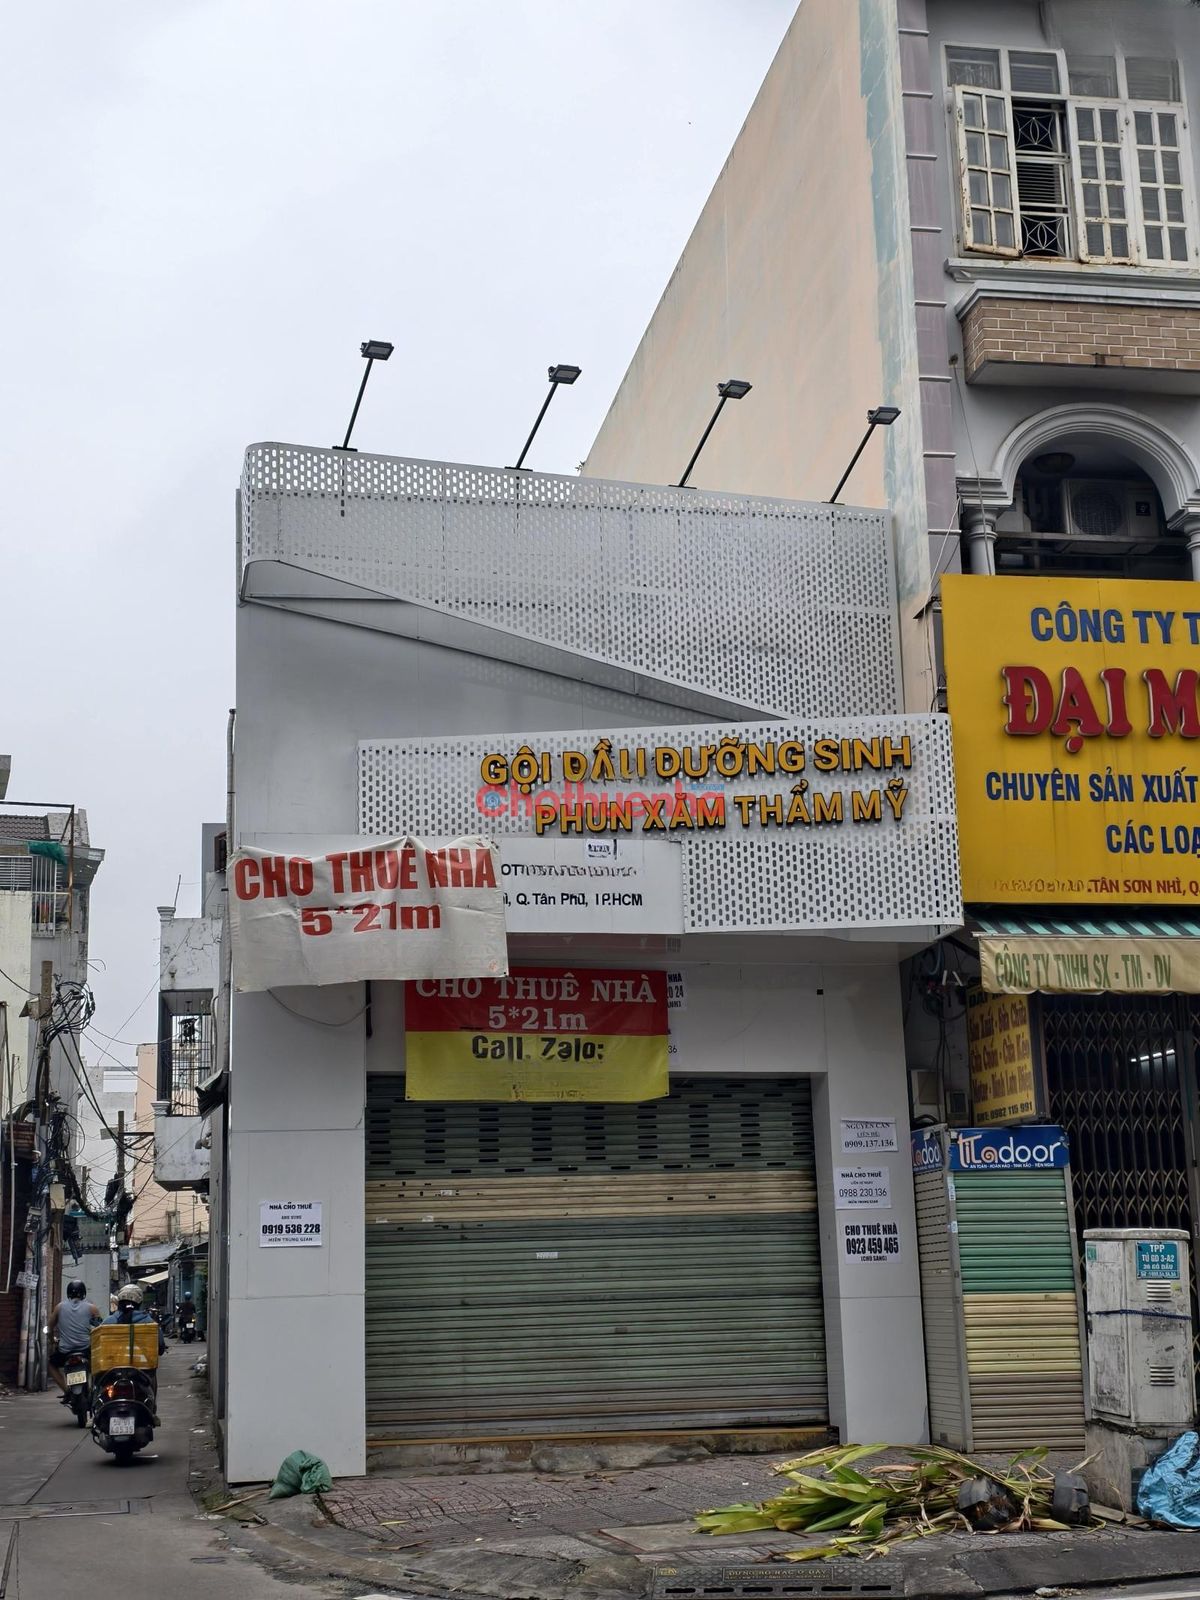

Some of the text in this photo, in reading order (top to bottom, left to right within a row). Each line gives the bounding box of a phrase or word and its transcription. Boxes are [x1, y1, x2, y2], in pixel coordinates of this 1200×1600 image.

[1031, 601, 1126, 643] CÔNG
[1132, 611, 1175, 644] TY
[1001, 666, 1133, 754] ĐẠI
[480, 745, 552, 795] GỘI
[655, 737, 805, 778] DƯỠNG
[813, 735, 912, 771] SINH
[986, 766, 1199, 804] CHUYÊN SẢN XUẤT
[535, 778, 909, 834] PHUN XĂM THẨM MỸ
[1105, 819, 1155, 855] CÁC
[234, 842, 497, 900] CHO THUÊ NHÀ
[1123, 879, 1152, 893] SƠN
[1156, 877, 1186, 896] NHÌ,
[995, 944, 1030, 987] CÔNG
[1033, 953, 1049, 986] TY
[1053, 953, 1090, 987] TNHH
[1093, 954, 1111, 988] SX
[1121, 954, 1144, 988] TM
[1154, 954, 1171, 988] DV
[415, 973, 656, 1003] CHO THUÊ NHÀ
[844, 1139, 894, 1149] 0909.137.136
[839, 1188, 887, 1197] 0988 230 136
[262, 1224, 320, 1234] 0919 536 228
[845, 1222, 897, 1235] CHO THUÊ NHÀ
[846, 1237, 899, 1254] 0923 459 465
